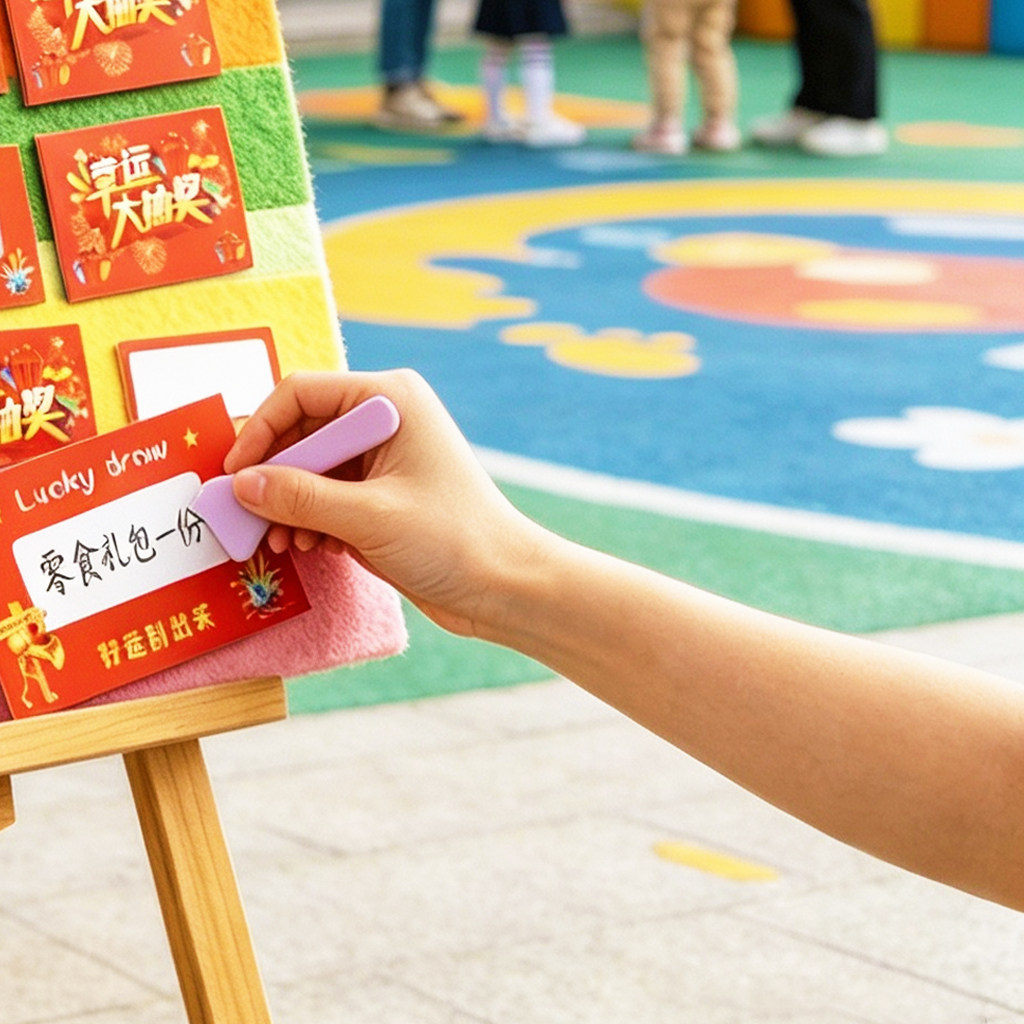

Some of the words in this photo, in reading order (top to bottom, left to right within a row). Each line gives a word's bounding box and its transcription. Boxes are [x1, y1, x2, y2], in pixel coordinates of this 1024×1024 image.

[14, 468, 94, 512] Lucky
[39, 506, 206, 595] 零食礼包一份
